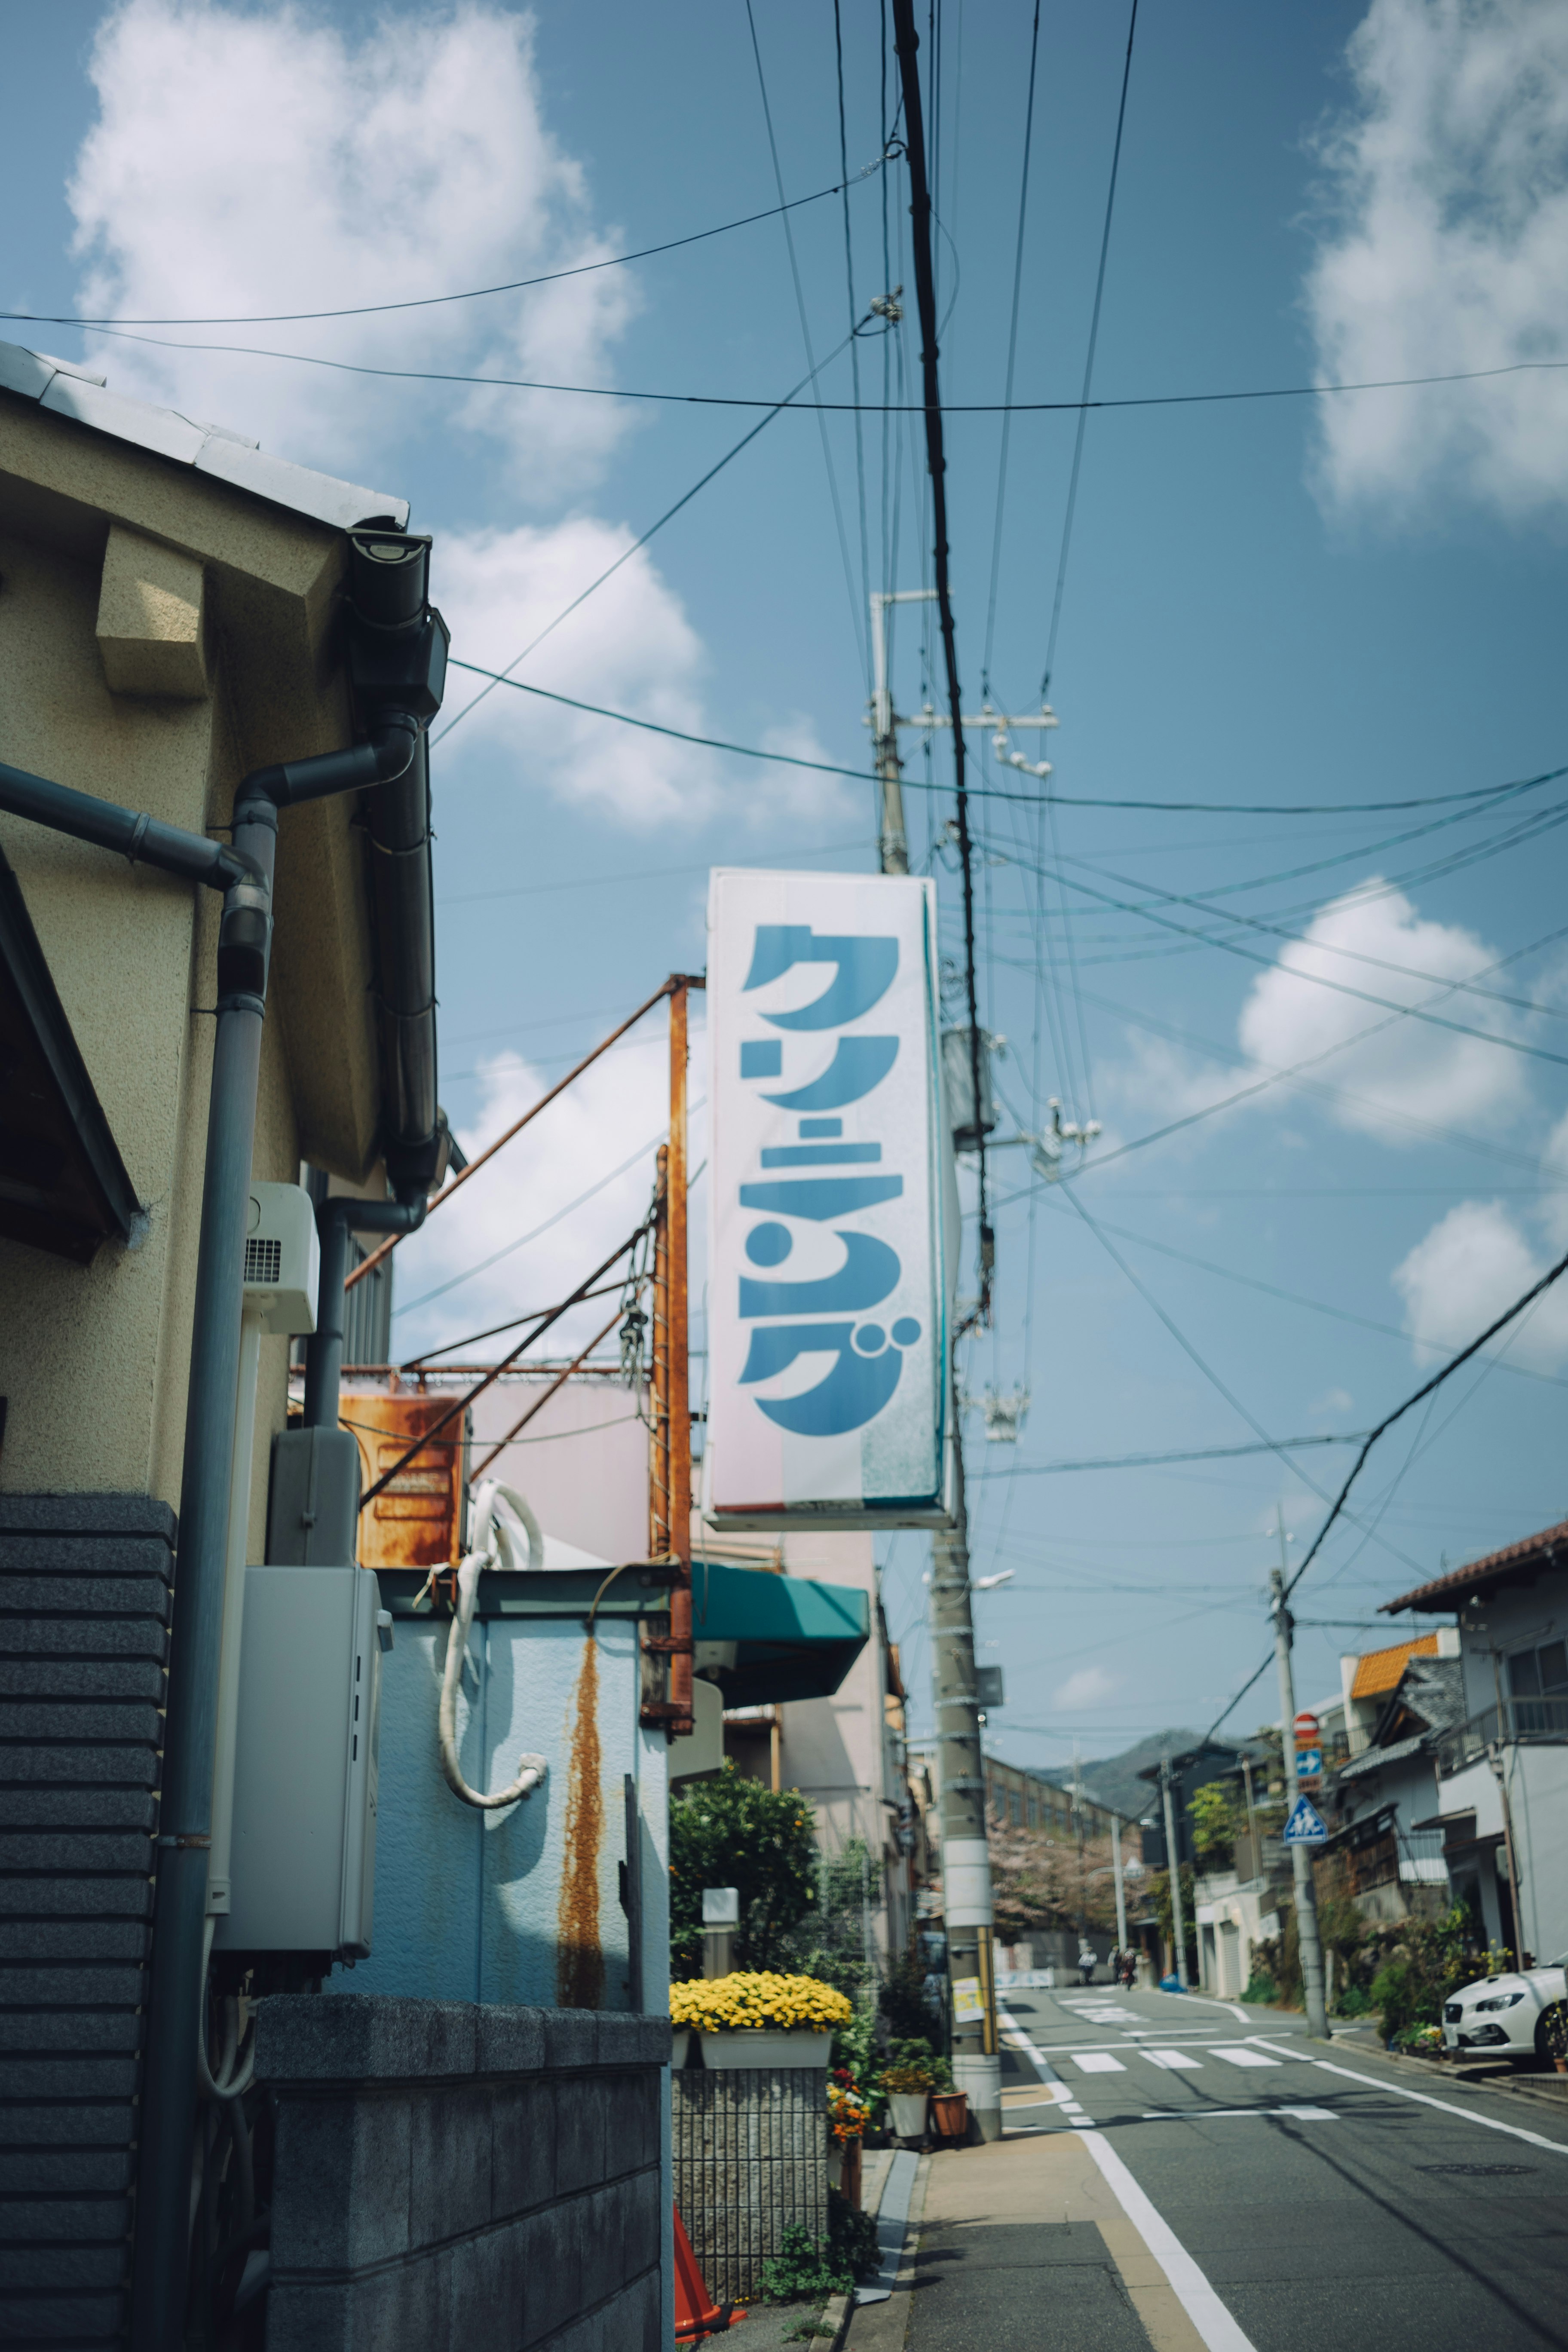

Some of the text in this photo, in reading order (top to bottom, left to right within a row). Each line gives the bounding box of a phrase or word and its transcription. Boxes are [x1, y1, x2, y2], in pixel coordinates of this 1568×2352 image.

[739, 925, 921, 1436] クリーニング
